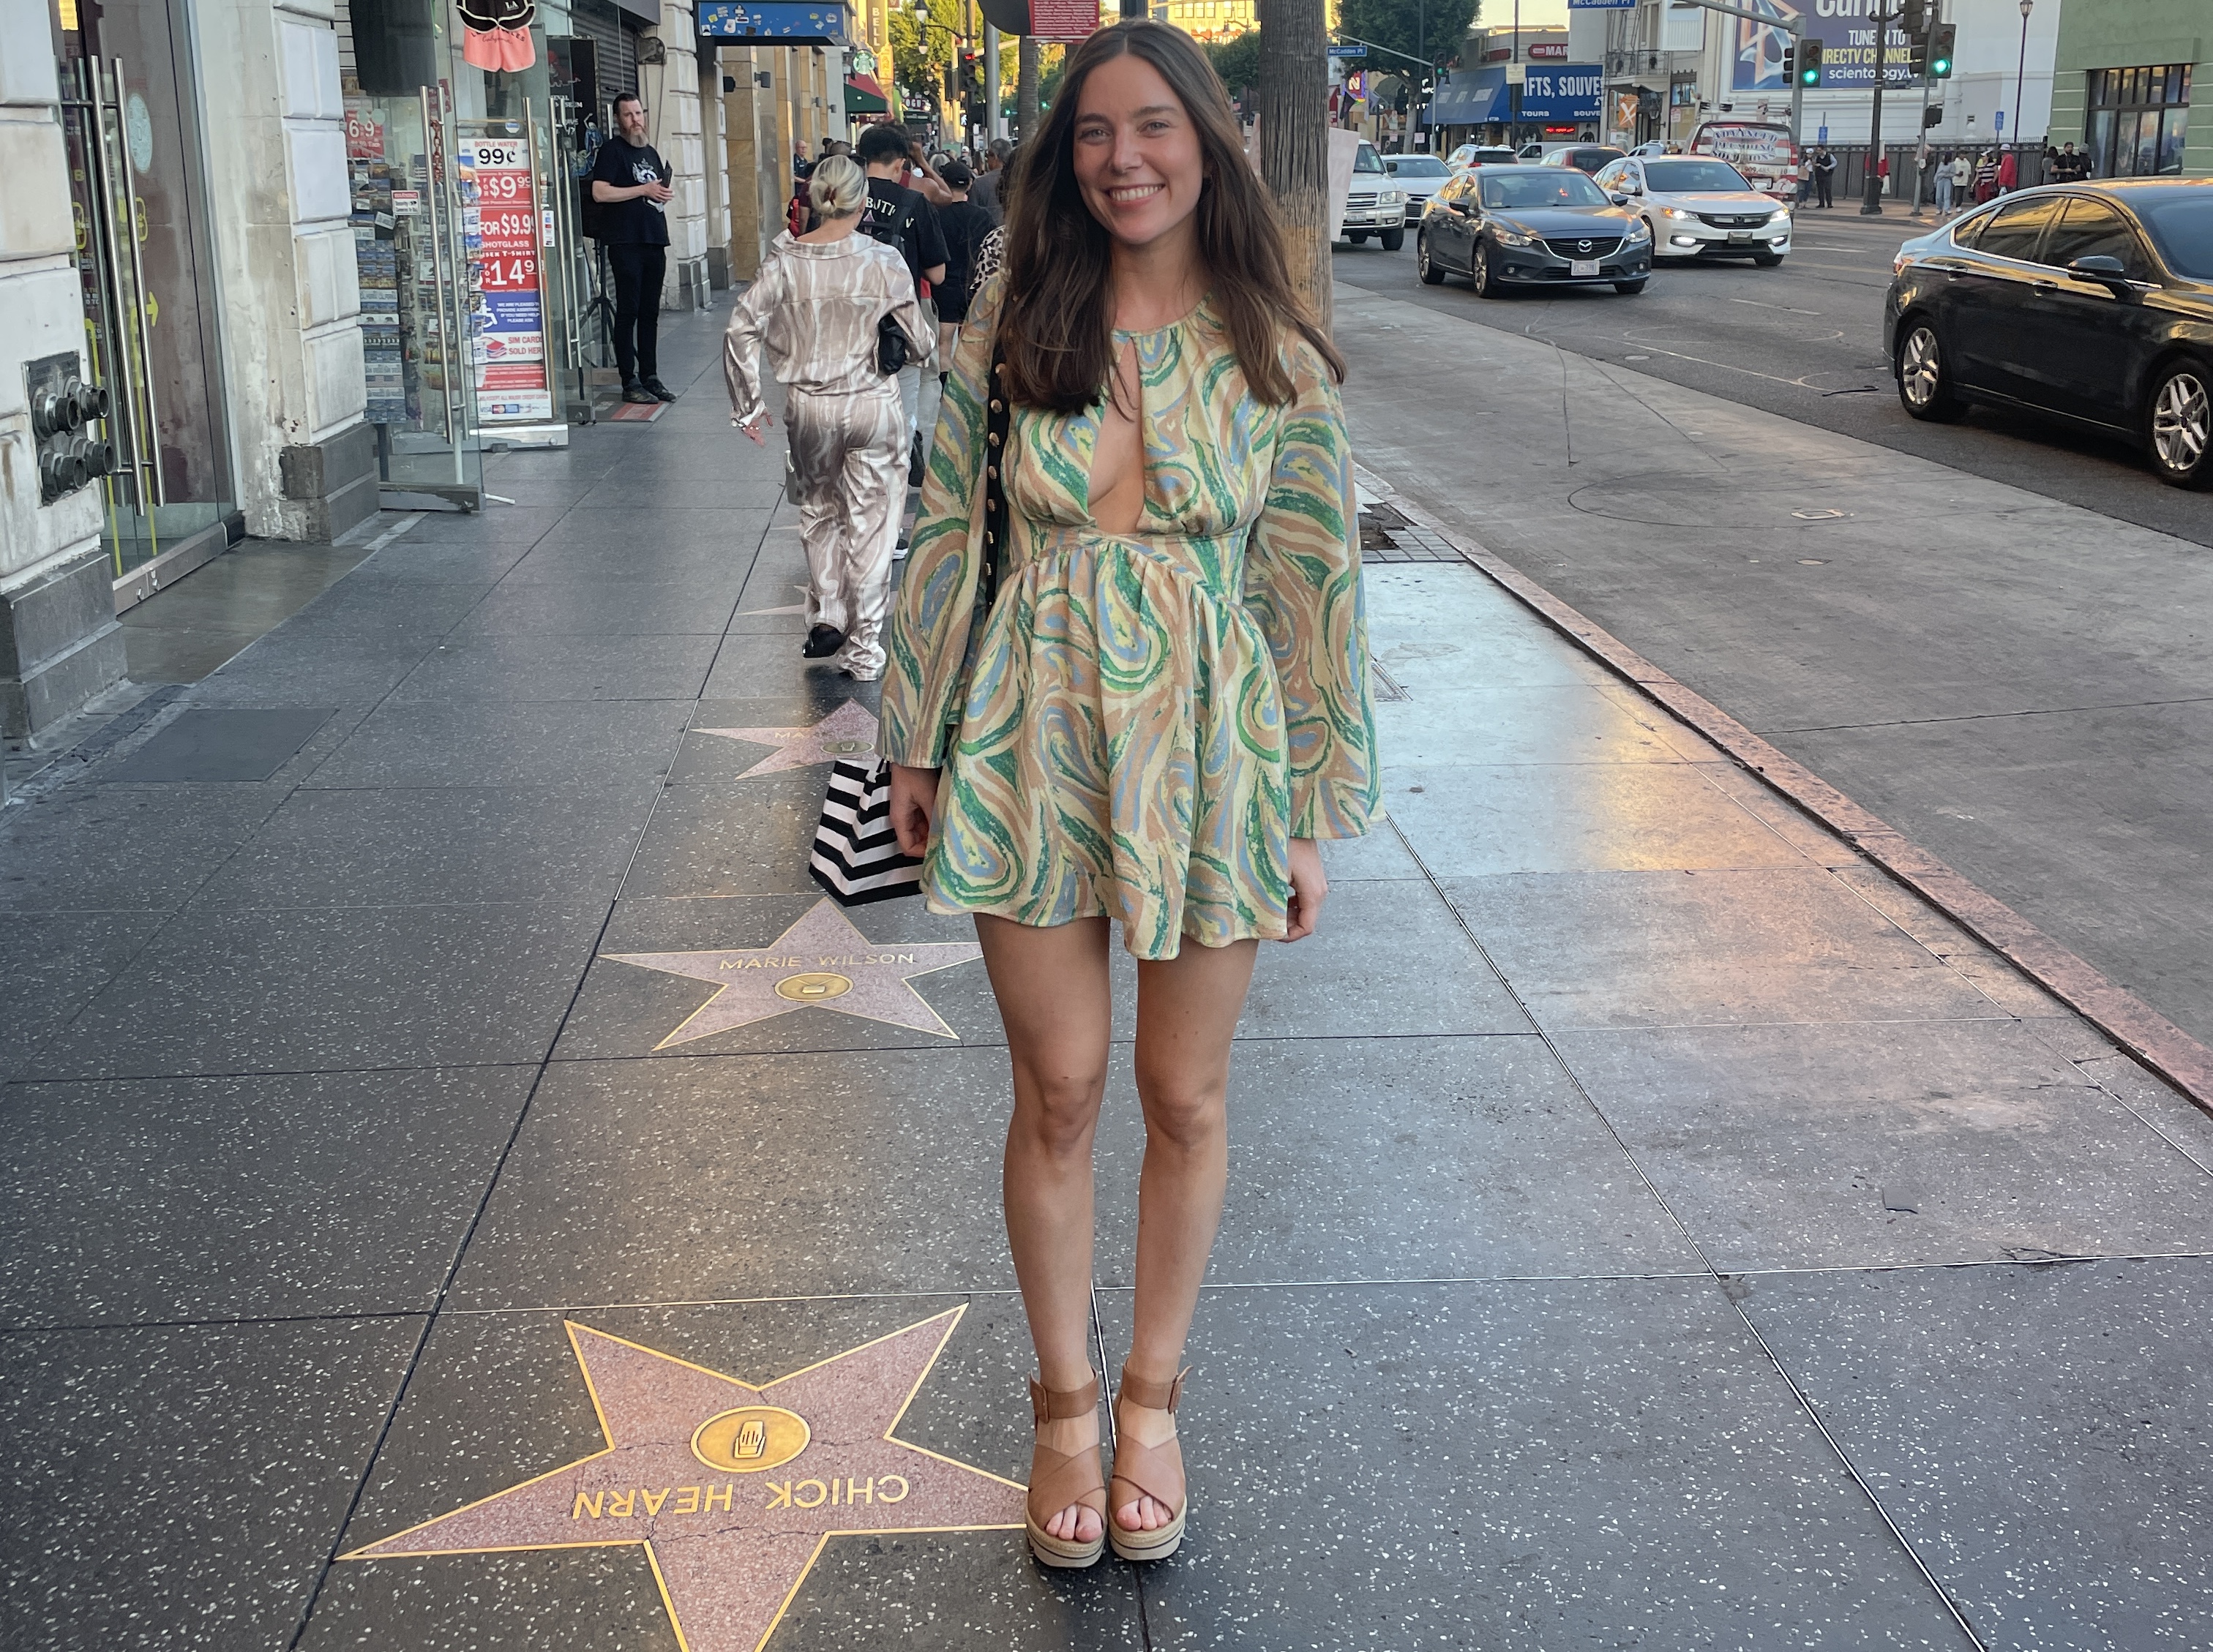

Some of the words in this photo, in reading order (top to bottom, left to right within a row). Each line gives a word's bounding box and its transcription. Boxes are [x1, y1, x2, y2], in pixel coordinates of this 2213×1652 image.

[872, 7, 880, 47] BELL
[1849, 29, 1877, 45] TUNE
[1891, 29, 1906, 45] TO
[1821, 48, 1862, 64] IRECTV
[1862, 48, 1913, 64] CHNNEL
[1828, 67, 1919, 80] scientoogy.tv
[1523, 76, 1556, 98] IFTS,
[1558, 76, 1603, 97] SOUVE
[902, 97, 926, 108] OGU
[1714, 129, 1778, 143] ADVANCED
[481, 240, 530, 249] SHOTGLASS
[719, 955, 802, 970] MARIE
[818, 953, 914, 966] WILSON
[765, 1474, 910, 1511] CHICK
[572, 1483, 735, 1520] HEARN
